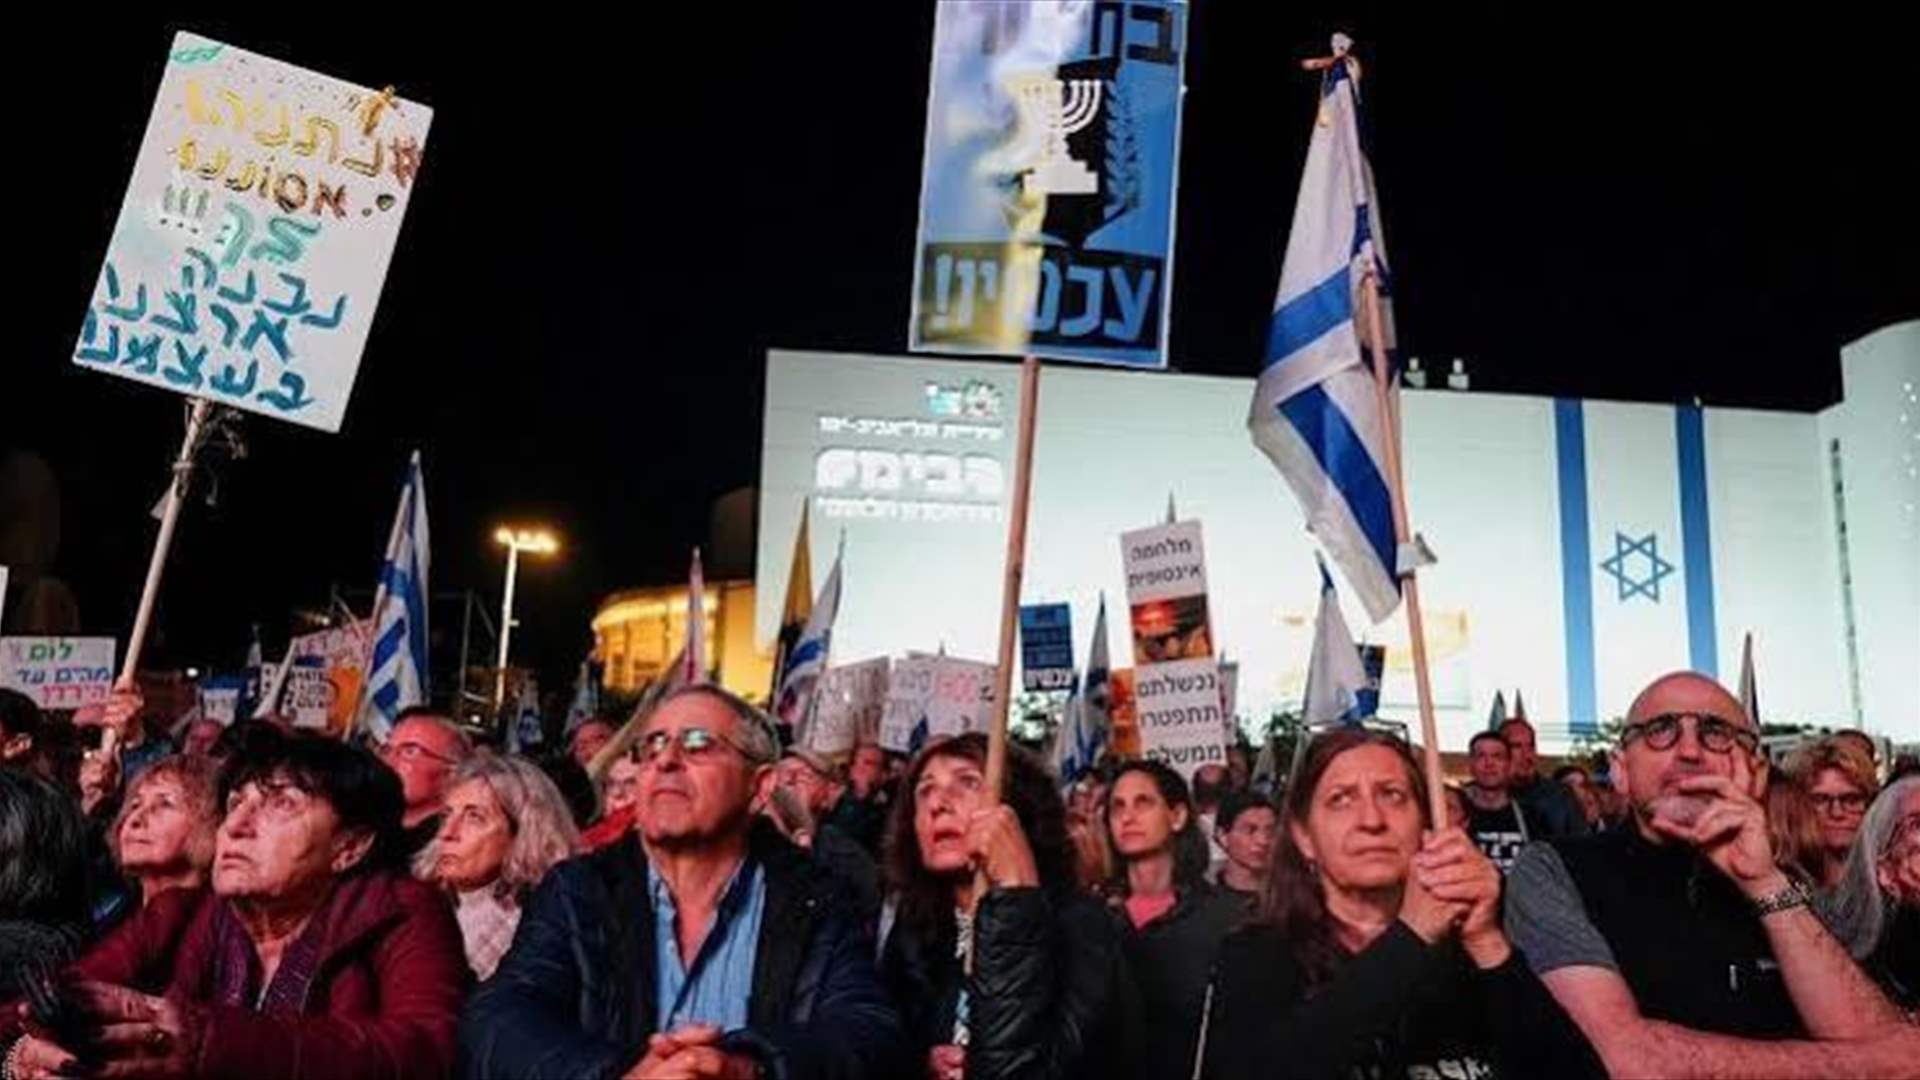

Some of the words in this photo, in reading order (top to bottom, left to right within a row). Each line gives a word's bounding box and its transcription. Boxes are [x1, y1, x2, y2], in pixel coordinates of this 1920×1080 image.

[185, 247, 347, 328] נבנה
[104, 262, 294, 364] ארצנו
[76, 308, 316, 412] בעצמנו
[1131, 538, 1192, 562] מלחמה
[1129, 563, 1202, 588] אינסופית
[1138, 673, 1217, 698] נכשלתם
[1140, 706, 1219, 729] תתפטרו
